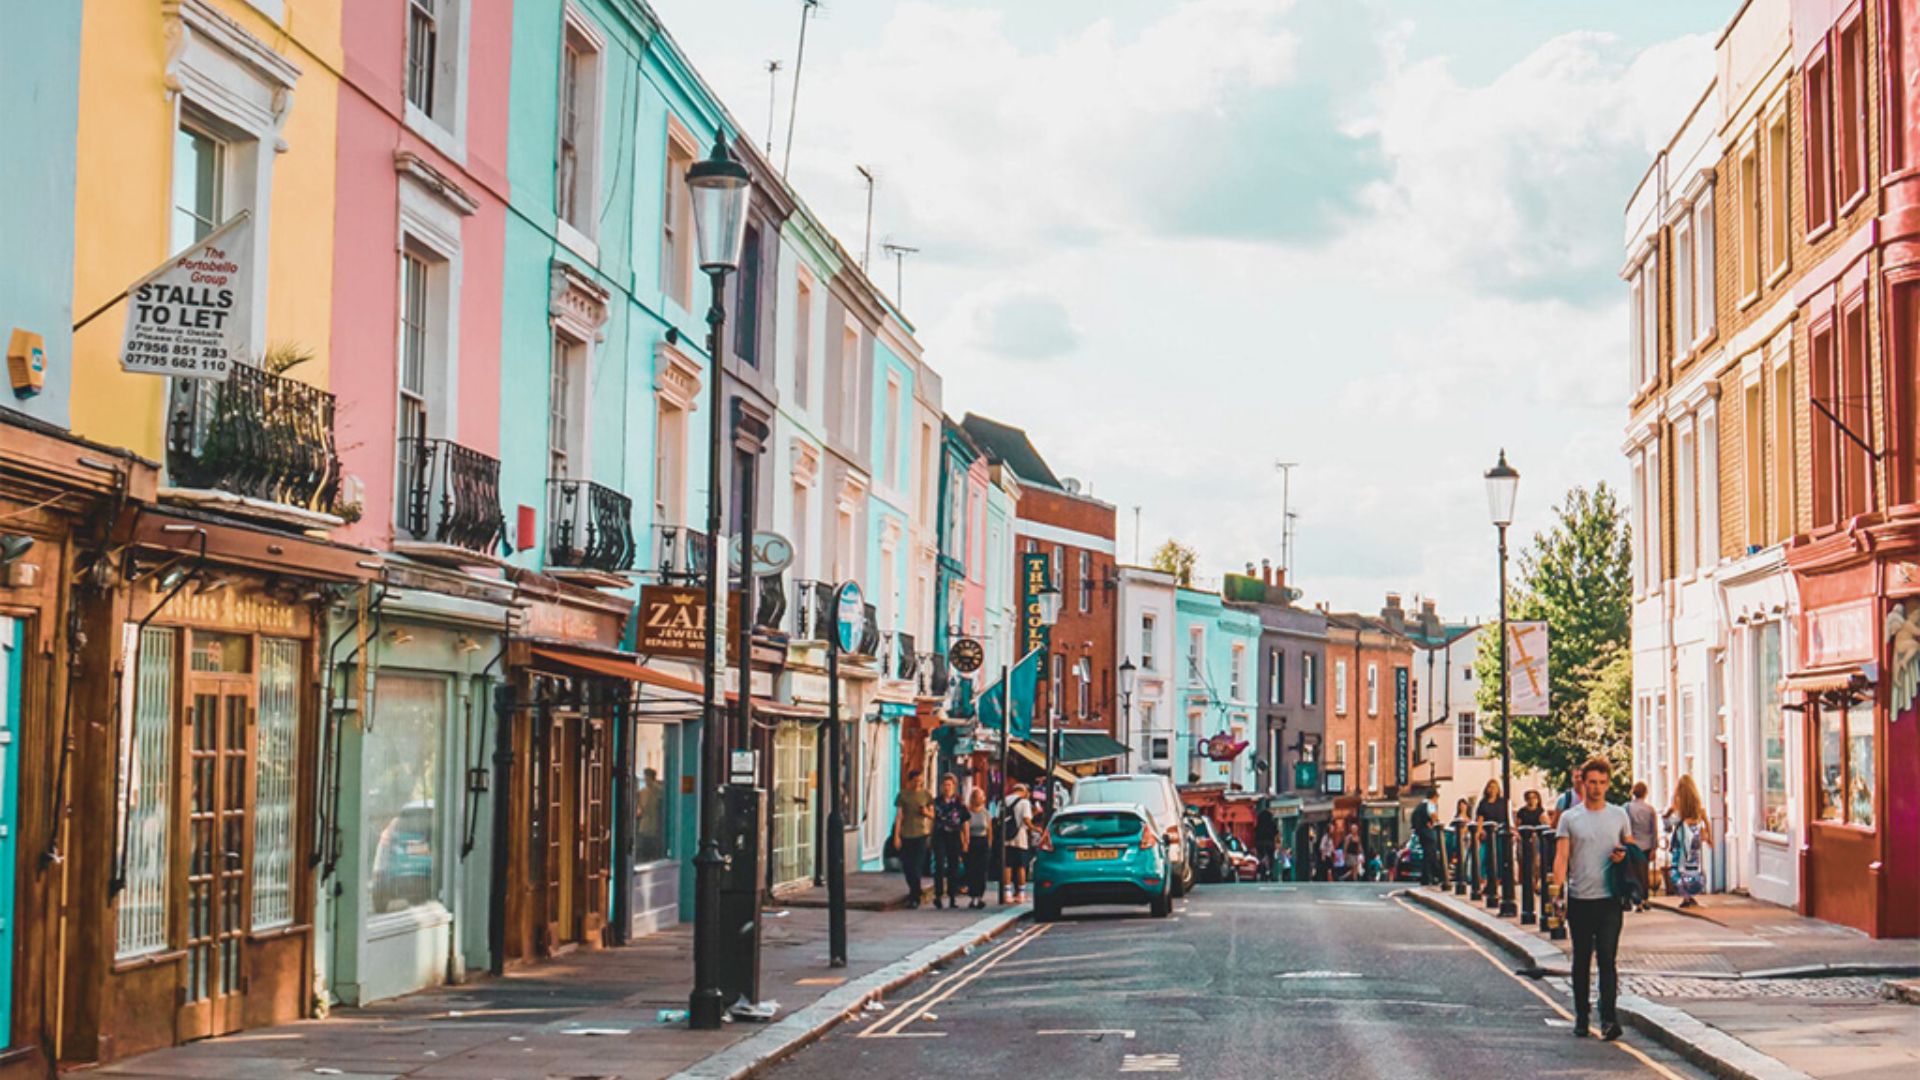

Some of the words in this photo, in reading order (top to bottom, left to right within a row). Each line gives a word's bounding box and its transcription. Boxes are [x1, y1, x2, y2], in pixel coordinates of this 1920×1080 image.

[205, 247, 225, 259] The
[177, 257, 238, 273] Portobello
[191, 271, 228, 287] Group
[136, 282, 233, 308] STALLS
[137, 304, 170, 325] TO
[179, 306, 229, 329] LET
[135, 324, 153, 332] For
[157, 326, 183, 335] More
[187, 329, 224, 338] Details
[136, 332, 172, 341] Please
[127, 340, 168, 353] 07956
[173, 344, 197, 356] 851
[202, 346, 228, 359] 283
[125, 353, 167, 366] 07795
[171, 357, 196, 369] 662
[202, 360, 226, 371] 110
[1029, 560, 1044, 595] THE
[645, 638, 684, 649] REPAIRS
